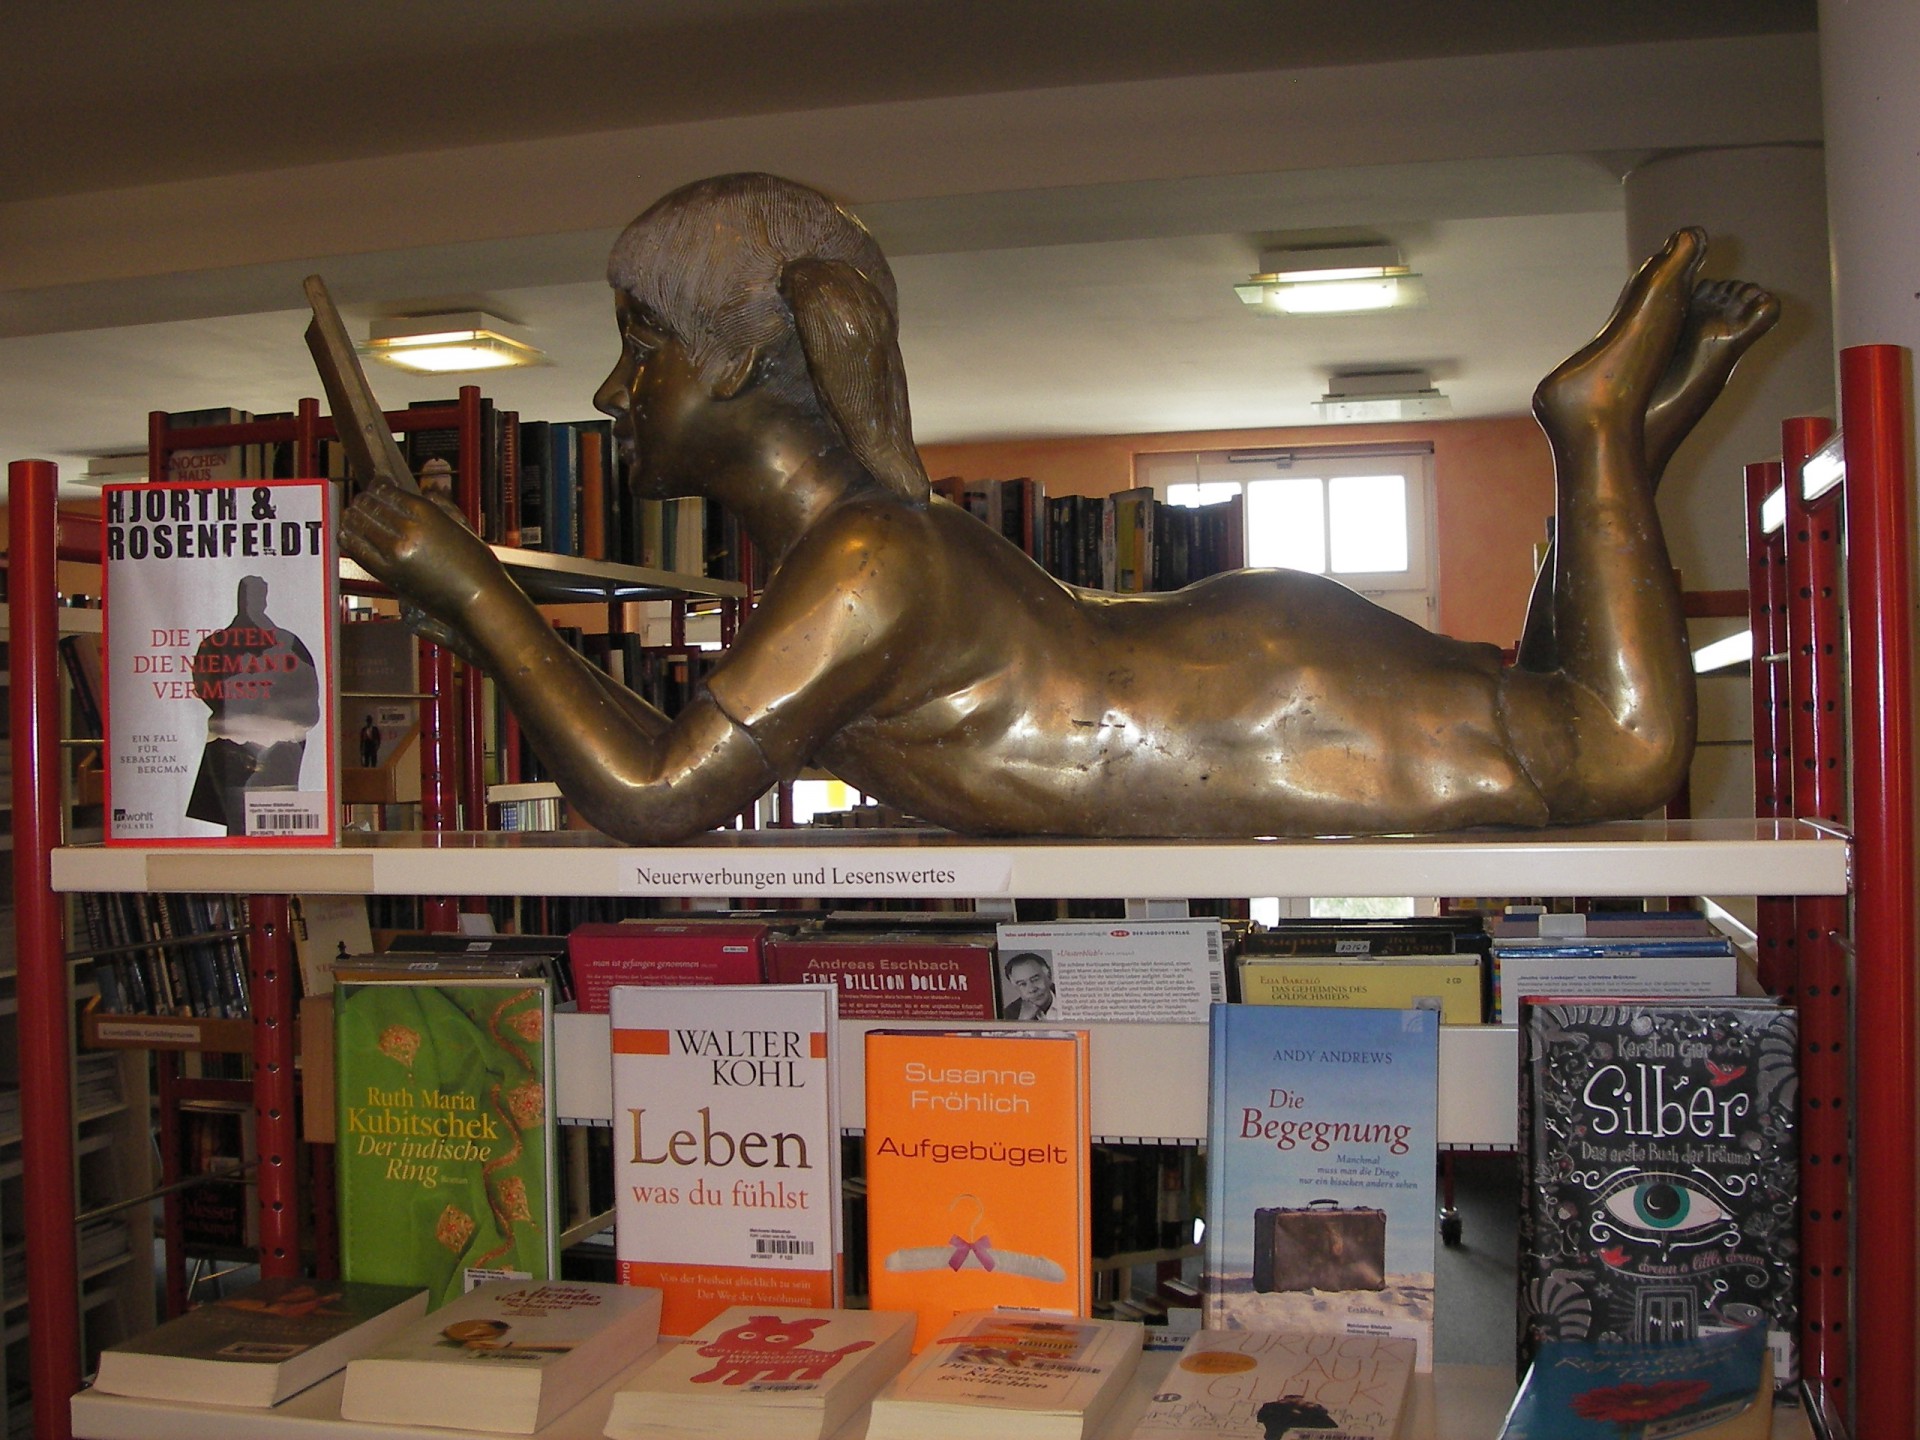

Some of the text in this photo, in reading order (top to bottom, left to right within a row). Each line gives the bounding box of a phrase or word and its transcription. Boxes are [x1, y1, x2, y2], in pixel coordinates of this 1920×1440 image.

[178, 469, 211, 482] HAUS
[108, 487, 276, 523] HJORTH &
[108, 521, 322, 560] ROSENFELDT
[151, 628, 285, 649] DIE TOTEN,
[133, 654, 298, 673] DIE NIEMAND
[153, 681, 273, 699] VERMISST
[132, 735, 150, 743] EIN
[138, 744, 158, 753] FÜR
[120, 756, 177, 764] SEBASTIAN
[138, 765, 188, 774] BERGMAN
[636, 867, 956, 889] Neuerwerbungen und Lesenswertes
[622, 959, 656, 969] gefangen
[657, 961, 700, 969] genommen
[808, 958, 960, 971] Andreas Eschbach
[844, 973, 904, 990] BILLION
[911, 973, 968, 991] DOLLAR
[1271, 992, 1350, 1000] GOLDSCHMIEDS
[675, 1029, 803, 1058] WALTER
[1618, 1033, 1675, 1060] Kerstin
[1273, 1049, 1393, 1065] ANDY ANDREWS
[712, 1059, 806, 1088] KOHL
[905, 1062, 1036, 1087] Susanne
[366, 1086, 476, 1111] Ruth Maria
[910, 1090, 1030, 1114] Fröhlich
[1269, 1088, 1304, 1110] Die
[1582, 1062, 1750, 1138] Silber
[348, 1107, 499, 1140] Kubitschek
[1240, 1107, 1412, 1155] Begegnung
[357, 1134, 492, 1163] Der indische
[627, 1106, 813, 1169] Leben
[876, 1136, 1068, 1167] Aufgebügelt
[1336, 1154, 1380, 1166] Manchmal
[1582, 1141, 1751, 1166] Das erste Buch der Träume
[385, 1158, 439, 1188] Ring
[1299, 1177, 1418, 1190] nur ein bisschen anders sehen
[1317, 1167, 1400, 1180] muss man die Dinge
[632, 1178, 810, 1210] was du fühlst
[1638, 1247, 1765, 1274] dream a little dream
[659, 1272, 812, 1289] Von der Freiheit glücklich zu sein
[697, 1288, 812, 1306] Der Weg der Versöhnung
[1196, 1331, 1404, 1363] ZURÜCK
[1292, 1357, 1390, 1382] AUF
